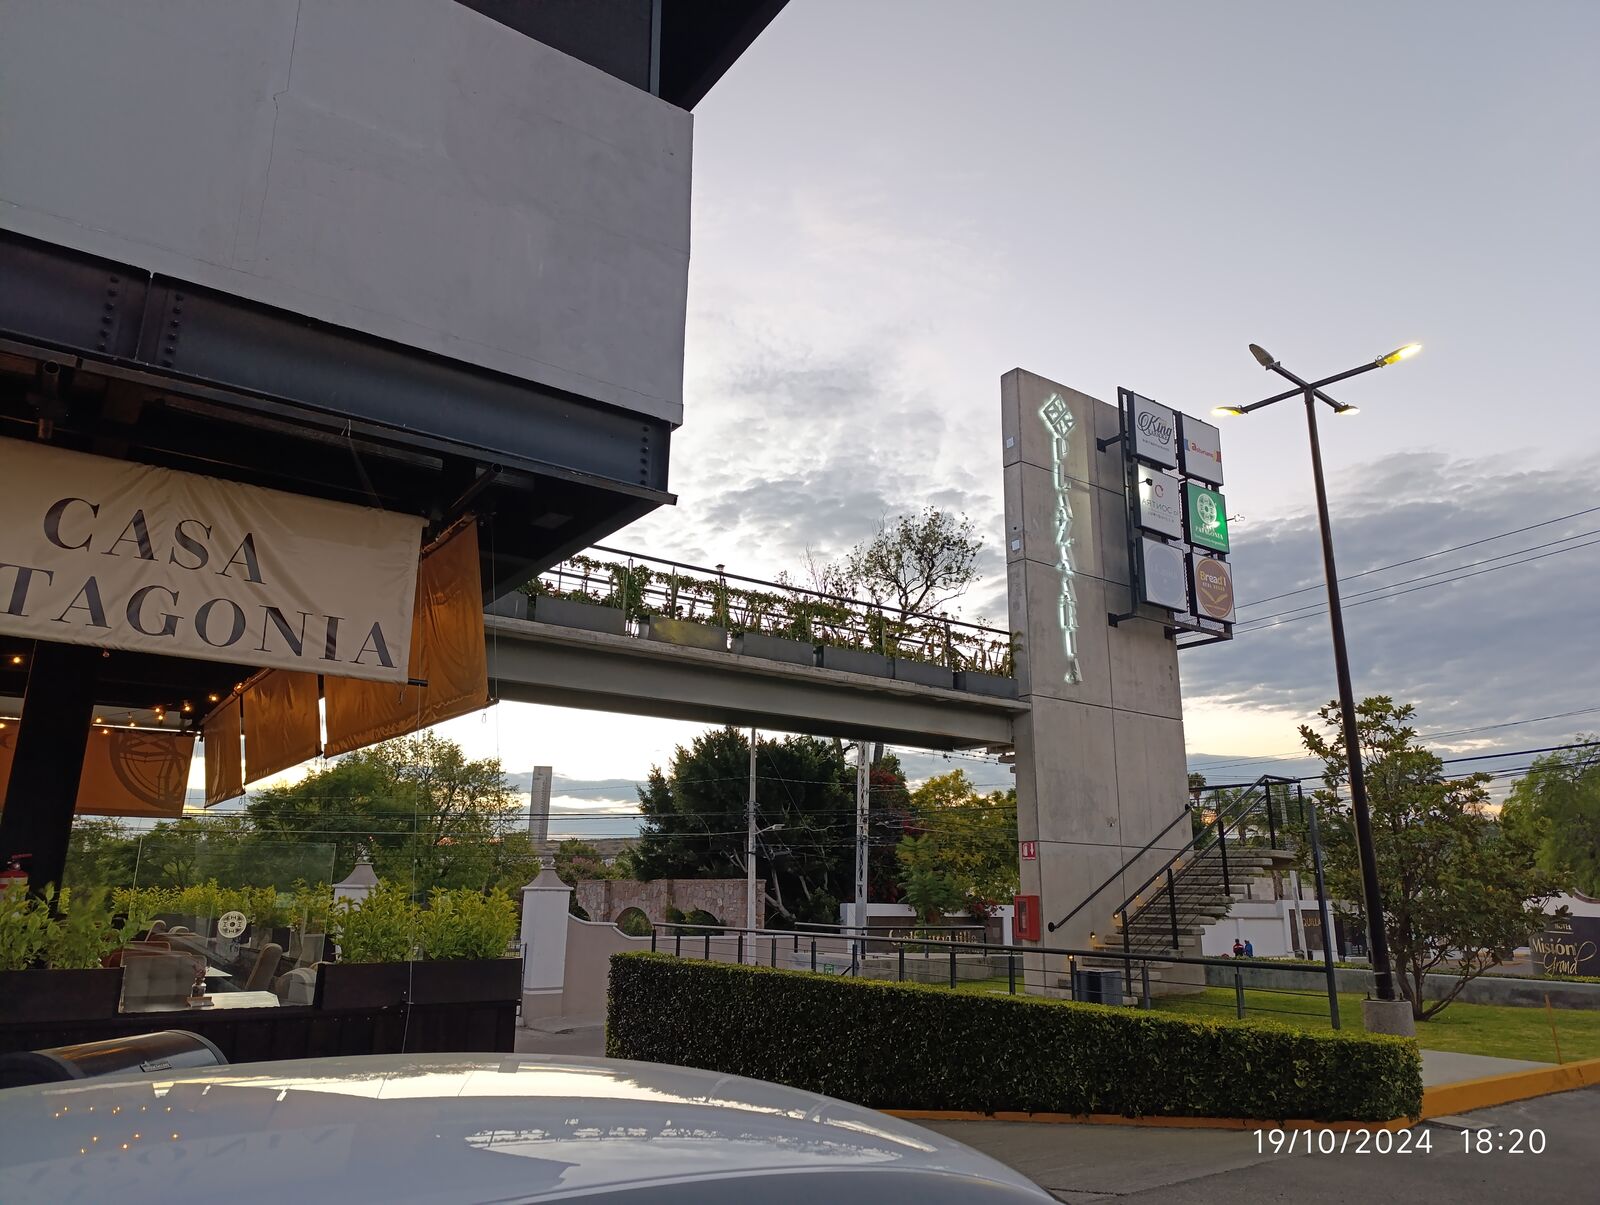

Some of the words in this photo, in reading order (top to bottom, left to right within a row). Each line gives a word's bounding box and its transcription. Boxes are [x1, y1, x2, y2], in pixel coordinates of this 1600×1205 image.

[1137, 411, 1172, 445] King
[43, 497, 266, 585] CASA
[0, 562, 397, 669] TAGONIA
[1532, 937, 1577, 956] Misión
[1543, 943, 1594, 978] Grand
